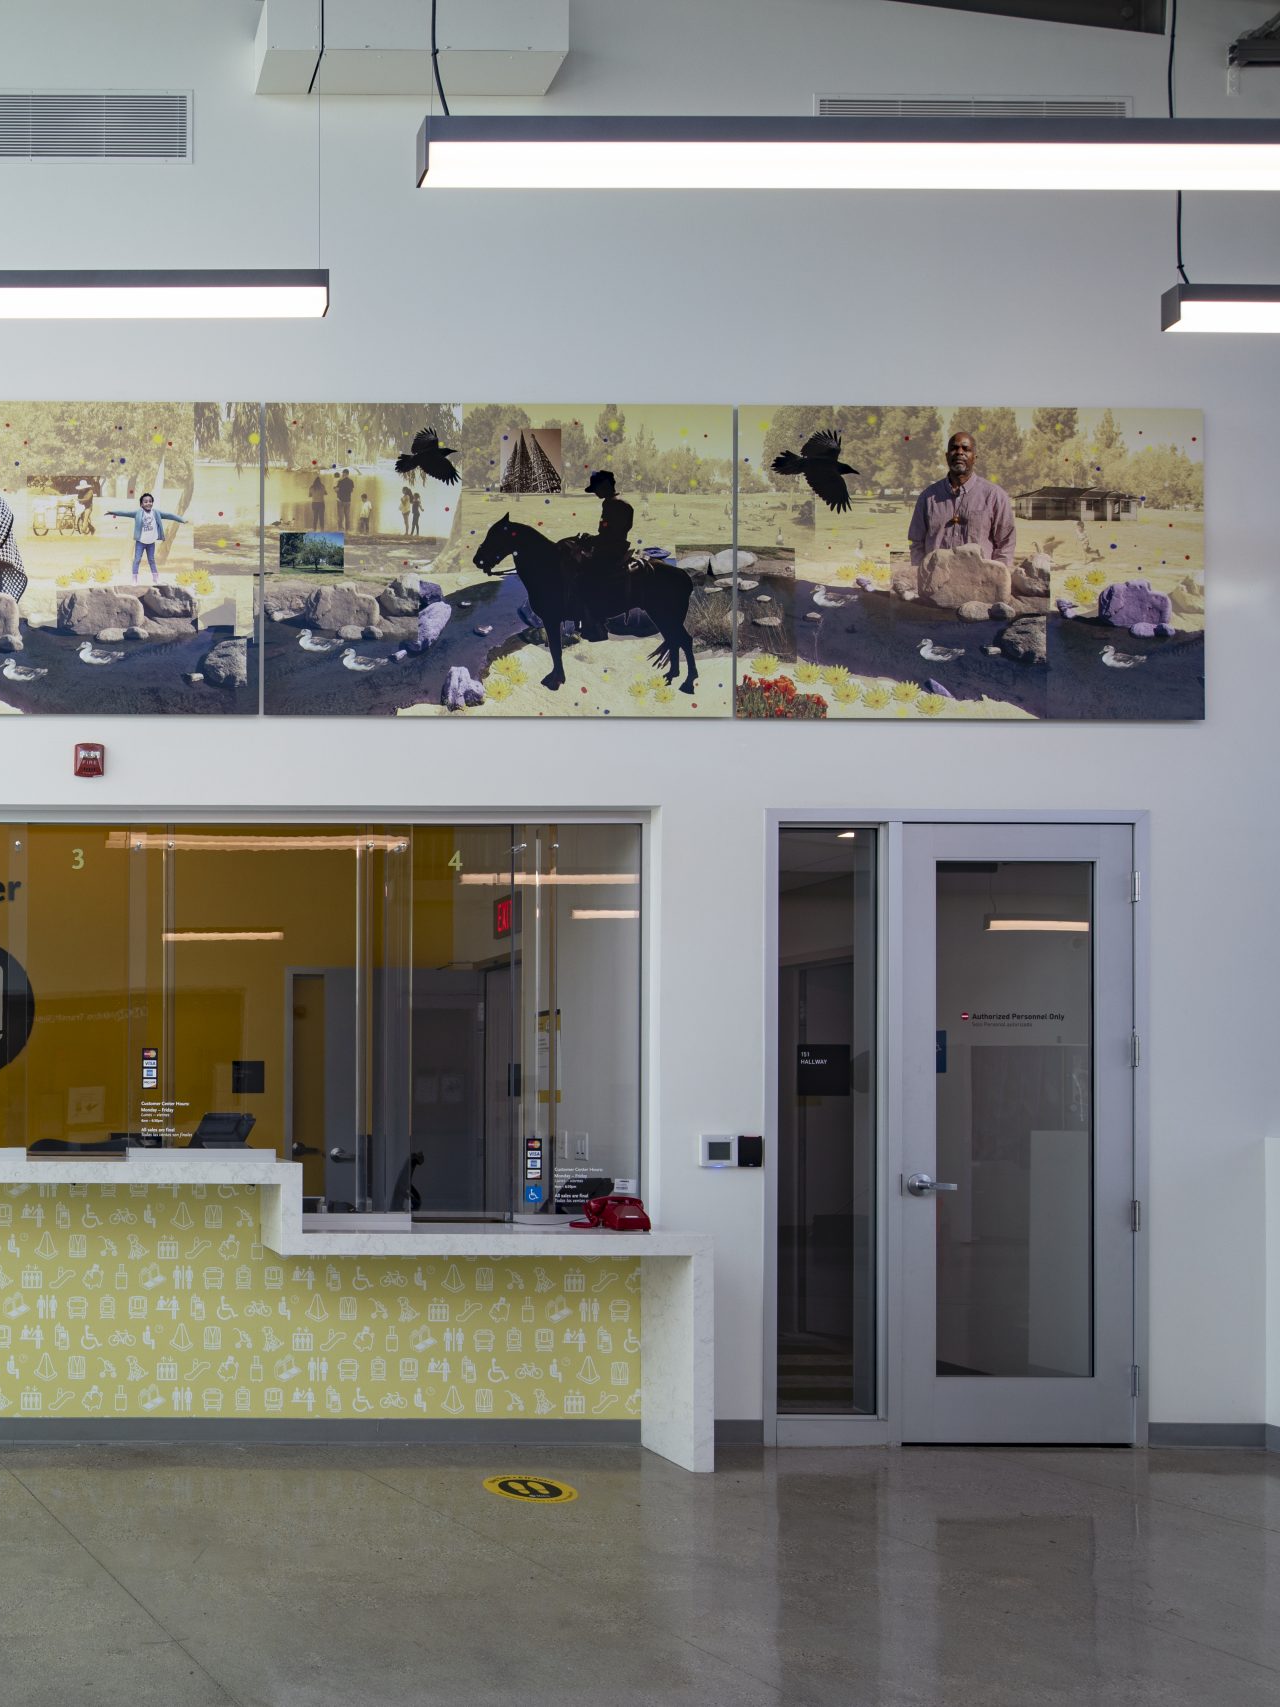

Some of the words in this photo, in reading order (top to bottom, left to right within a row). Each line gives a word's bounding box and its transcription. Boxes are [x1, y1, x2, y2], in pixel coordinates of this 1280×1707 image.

[72, 848, 84, 869] 3
[447, 850, 463, 871] 4
[1050, 1013, 1065, 1021] Only
